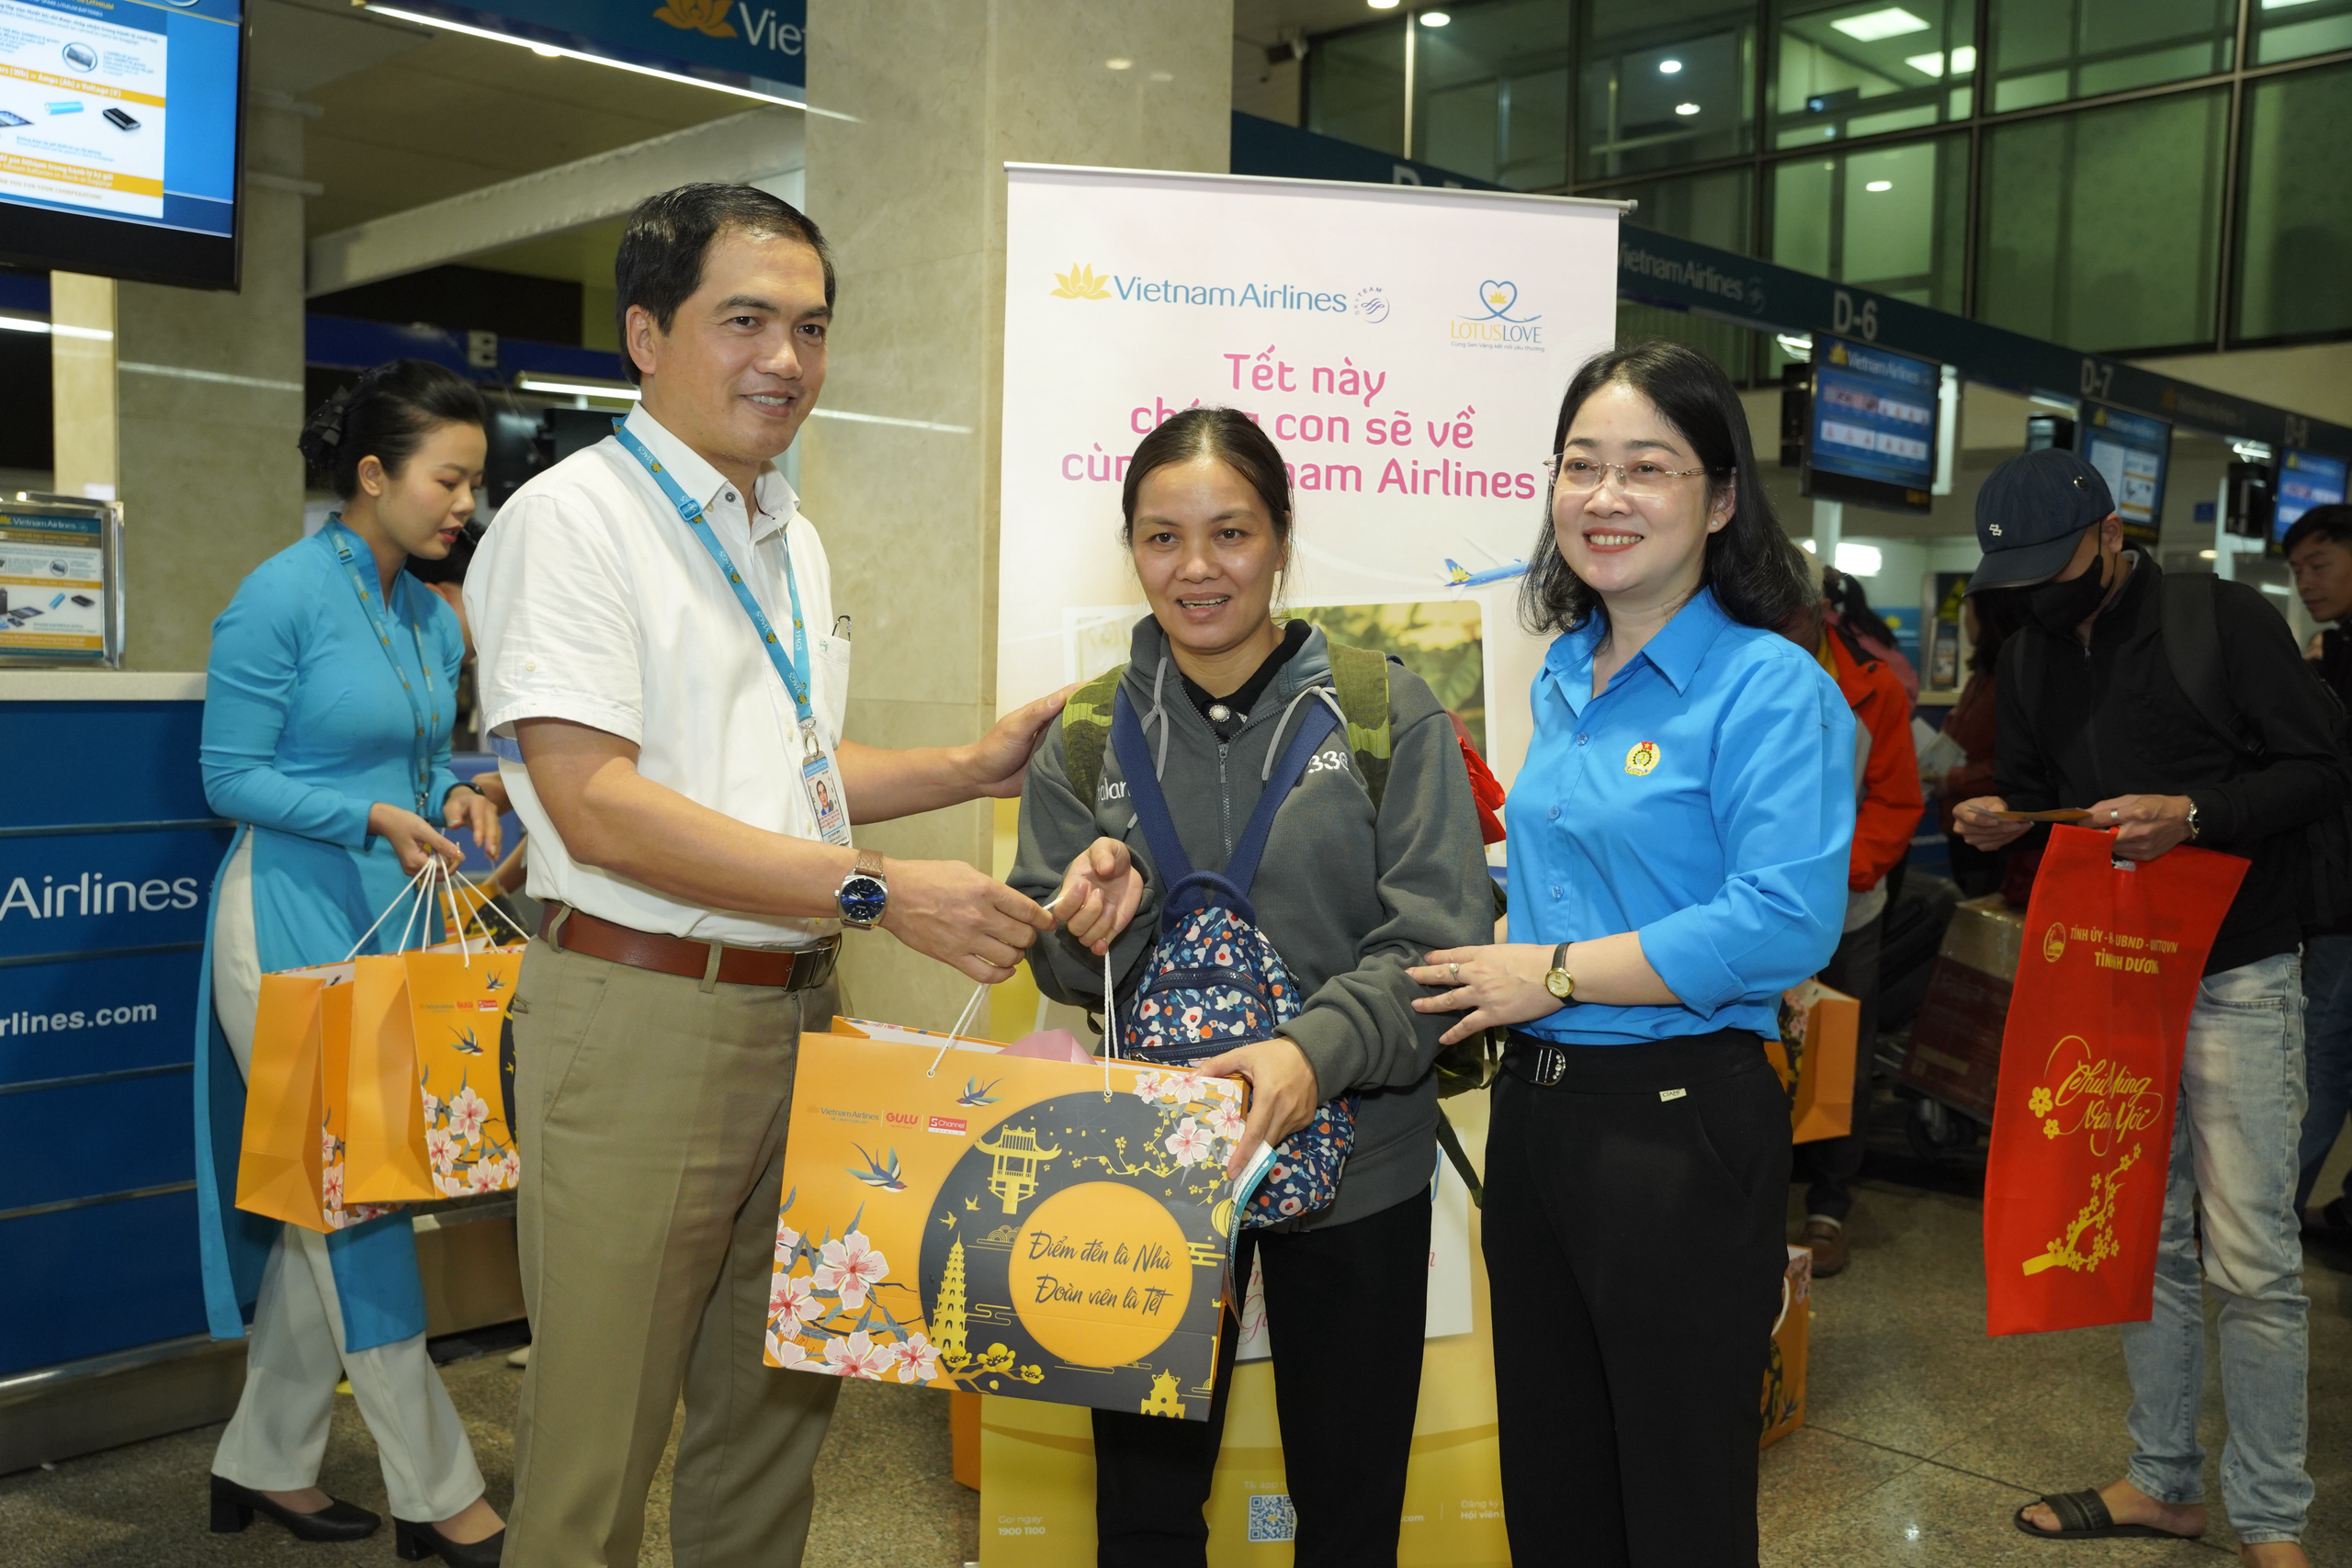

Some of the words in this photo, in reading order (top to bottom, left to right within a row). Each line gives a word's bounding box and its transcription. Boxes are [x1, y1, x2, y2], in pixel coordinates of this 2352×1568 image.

[738, 2, 806, 56] Vie
[1114, 275, 1235, 308] Vietnam
[1238, 282, 1348, 313] Airlines
[1833, 290, 1878, 341] D-6
[1223, 344, 1298, 392] Tết
[1312, 355, 1386, 408] này
[1275, 412, 1350, 444] con
[1365, 411, 1413, 446] sẽ
[1427, 404, 1476, 450] về
[1376, 457, 1536, 500] Airlines
[0, 871, 199, 919] Airlines
[820, 1106, 851, 1118] Vietnam
[851, 1110, 879, 1121] Airlines
[886, 1111, 919, 1126] GULU
[938, 1119, 966, 1129] Channel
[1029, 1229, 1079, 1260] Điểm
[1080, 1238, 1109, 1264] đến
[1114, 1242, 1131, 1266] là
[1132, 1241, 1173, 1273] Nhà
[1228, 1214, 1239, 1257] Economy
[1035, 1273, 1083, 1304] Đoàn
[1088, 1288, 1118, 1309] viên
[1122, 1286, 1140, 1310] là
[1141, 1285, 1174, 1316] Tết
[998, 1527, 1023, 1536] 1900
[1023, 1526, 1046, 1535] 1100
